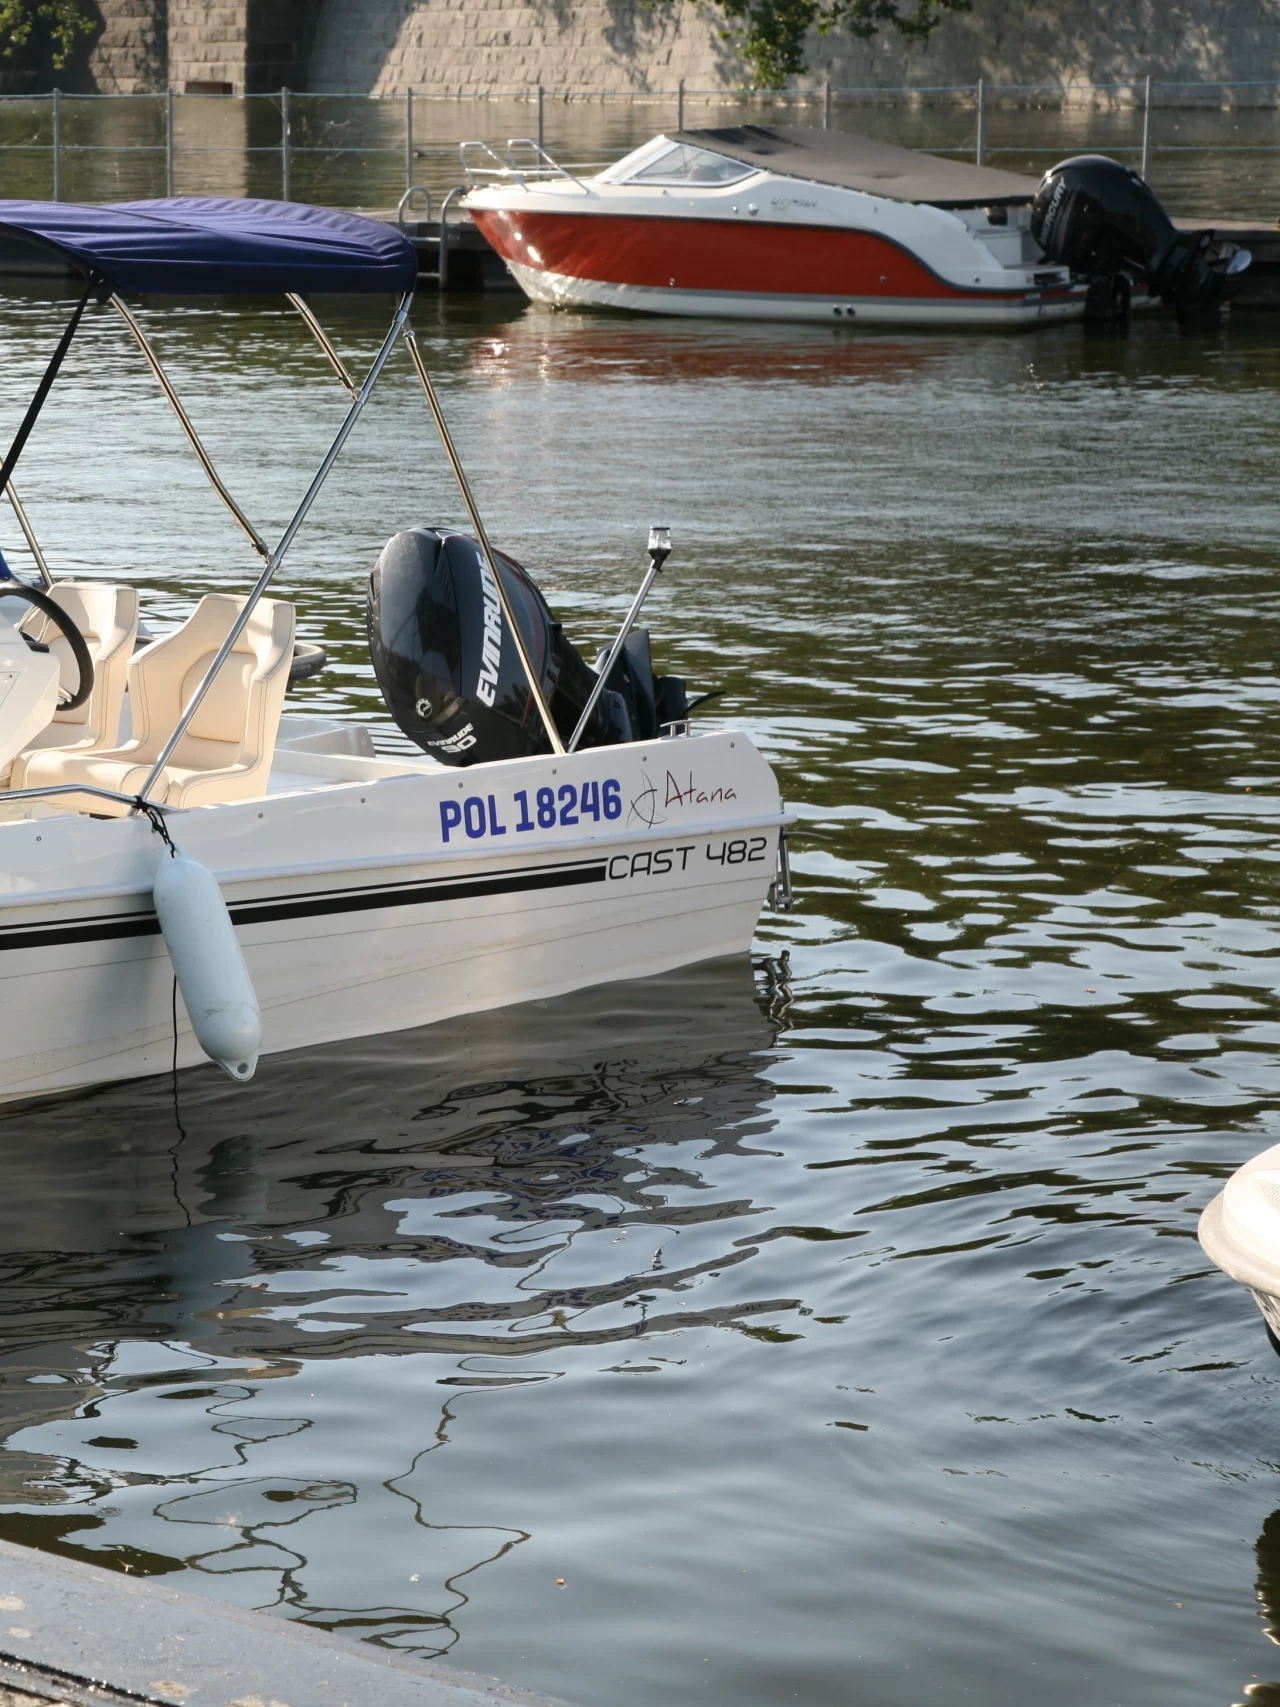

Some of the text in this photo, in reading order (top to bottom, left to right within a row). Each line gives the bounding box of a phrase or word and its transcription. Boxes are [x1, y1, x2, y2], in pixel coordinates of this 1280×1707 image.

[476, 551, 502, 708] EVINRUDE
[427, 722, 474, 746] EVINRUDE
[441, 734, 477, 753] 90
[665, 769, 737, 807] Atana
[439, 778, 623, 843] POL 18246
[608, 836, 768, 880] CAST 482
